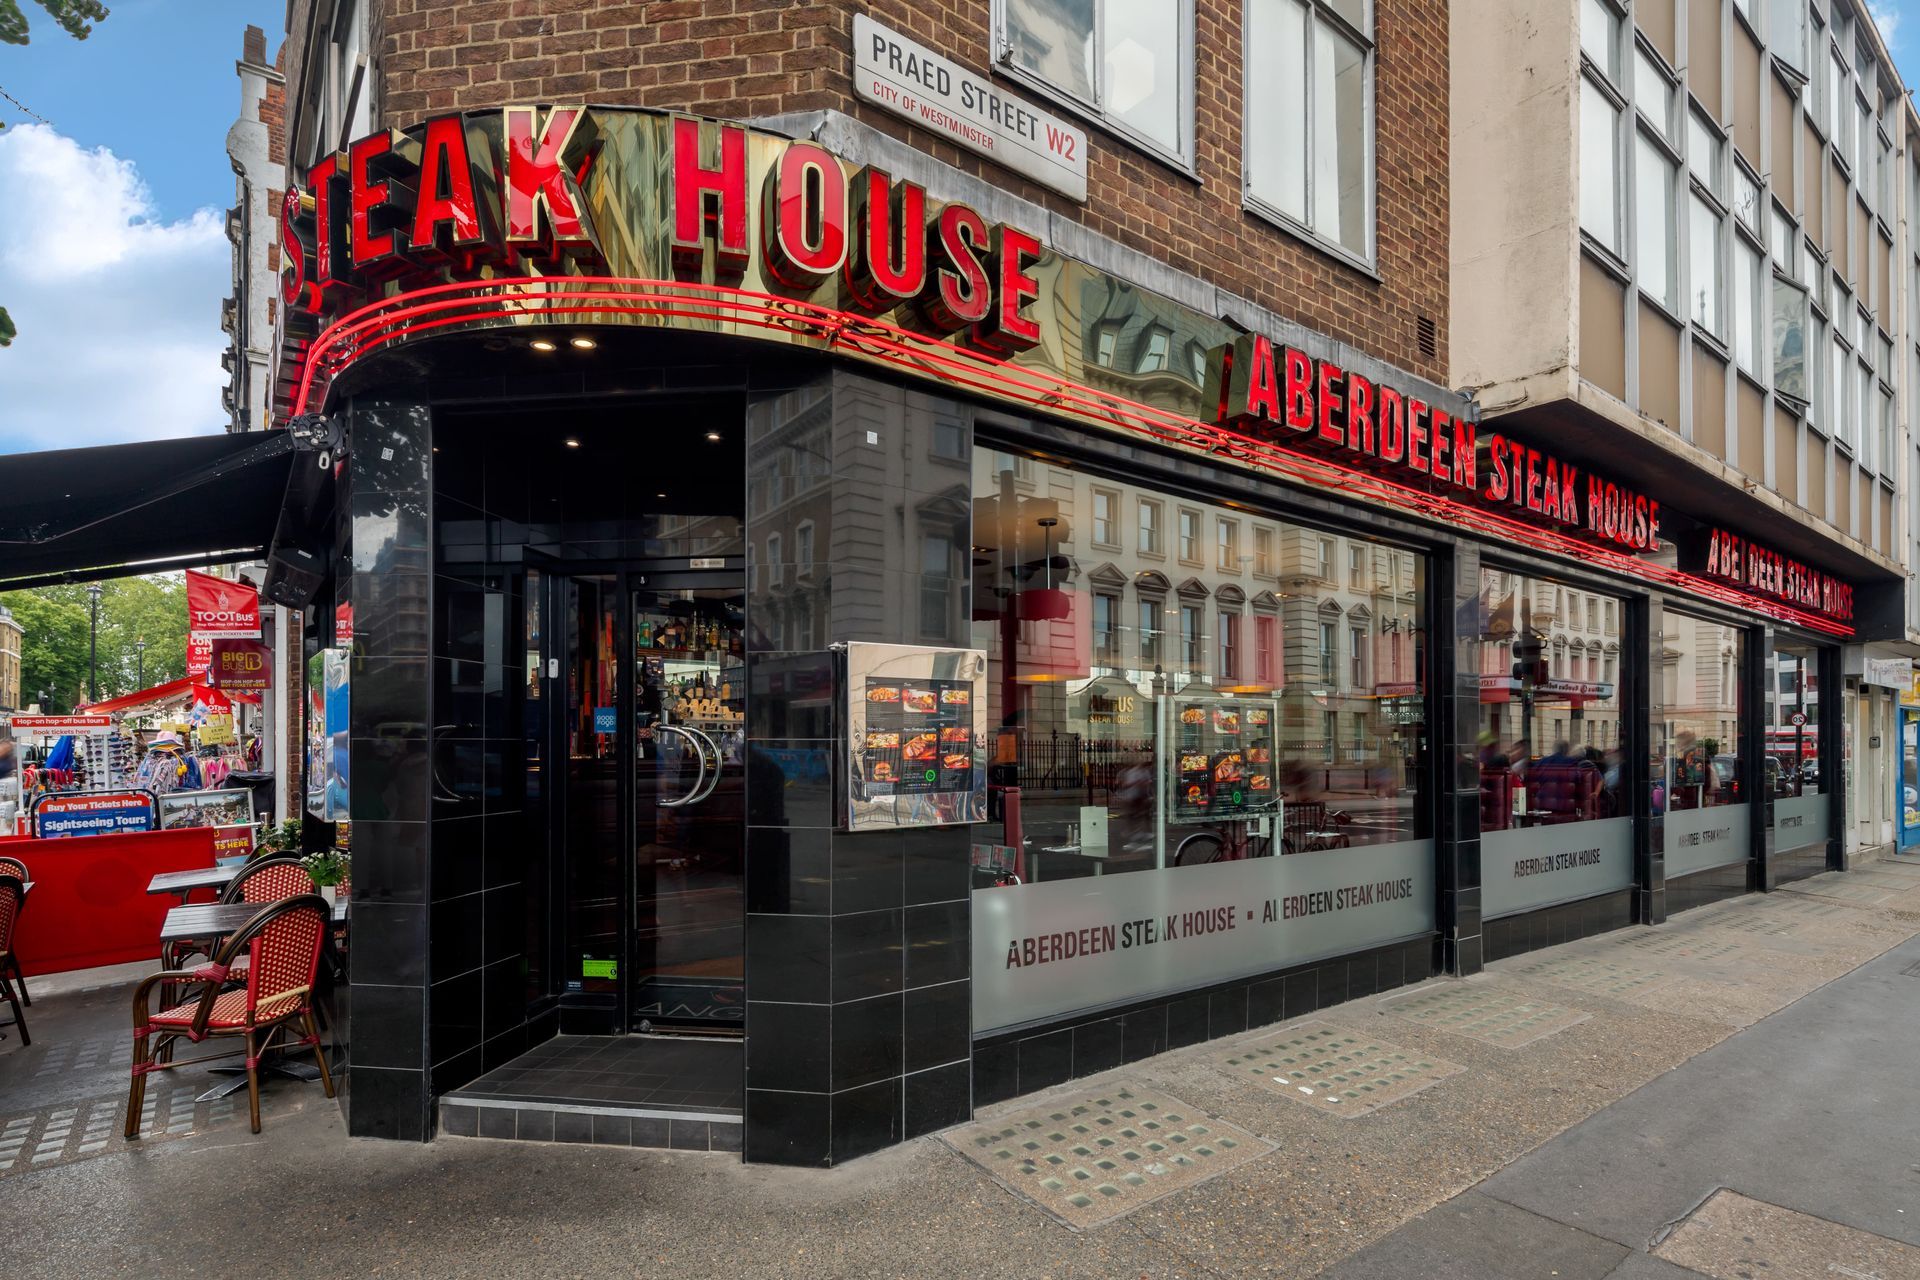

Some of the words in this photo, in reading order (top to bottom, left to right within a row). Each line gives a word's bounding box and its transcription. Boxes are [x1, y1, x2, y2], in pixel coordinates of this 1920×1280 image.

[872, 33, 951, 97] PRAED
[961, 80, 1039, 141] STREET
[1046, 124, 1076, 162] W2
[873, 81, 899, 104] CITY
[902, 96, 917, 112] OF
[919, 103, 994, 150] WESTMINSTER
[281, 105, 592, 306] STEAK
[669, 112, 1042, 352] HOUSE
[1247, 332, 1477, 490] ABERDEEN
[1490, 433, 1579, 526] STEAK
[1588, 473, 1661, 551] HOUSE
[1787, 559, 1821, 608] STEAK
[1823, 574, 1854, 620] HOUSE
[190, 638, 212, 646] LON
[195, 647, 208, 655] ST
[222, 652, 244, 661] BIG
[222, 661, 245, 671] BUS
[47, 804, 65, 812] Buy
[67, 803, 88, 811] Your
[89, 801, 121, 809] Tickets
[45, 818, 114, 831] Sightseeing
[115, 816, 146, 825] Tours
[227, 840, 249, 849] HERE
[1514, 855, 1554, 878] ABERDEEN
[1556, 852, 1578, 871] STEAK
[1579, 848, 1600, 866] HOUSE
[1006, 925, 1116, 969] ABERDEEN
[1121, 915, 1178, 949] STEAK
[1182, 906, 1236, 938] HOUSE
[1336, 884, 1375, 910] STEAK
[1376, 878, 1412, 903] HOUSE
